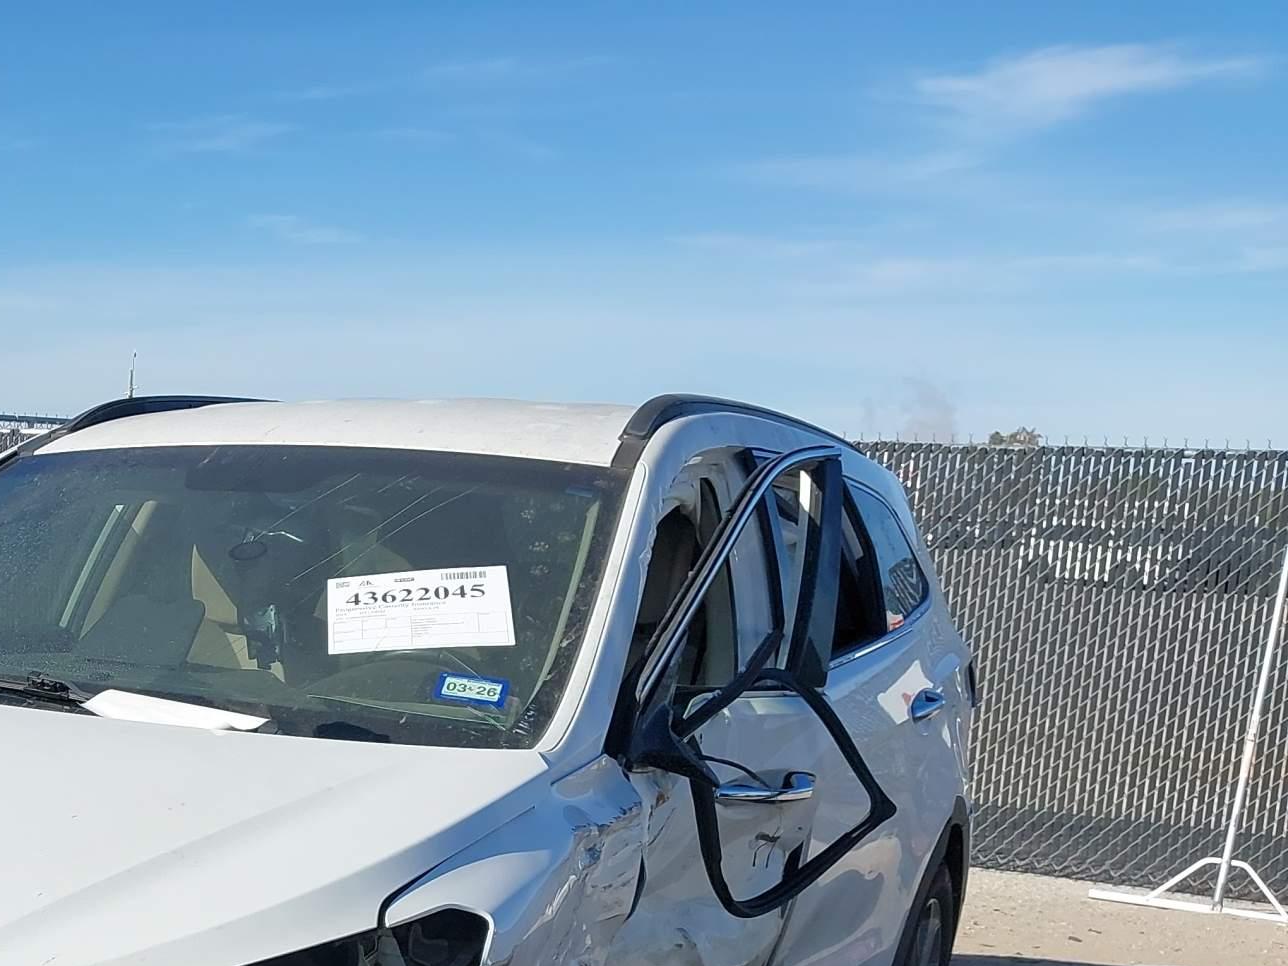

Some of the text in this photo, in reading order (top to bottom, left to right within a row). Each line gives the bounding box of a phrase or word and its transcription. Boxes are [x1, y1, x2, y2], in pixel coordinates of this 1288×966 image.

[345, 583, 486, 606] 43622045
[446, 681, 497, 697] 03 26
